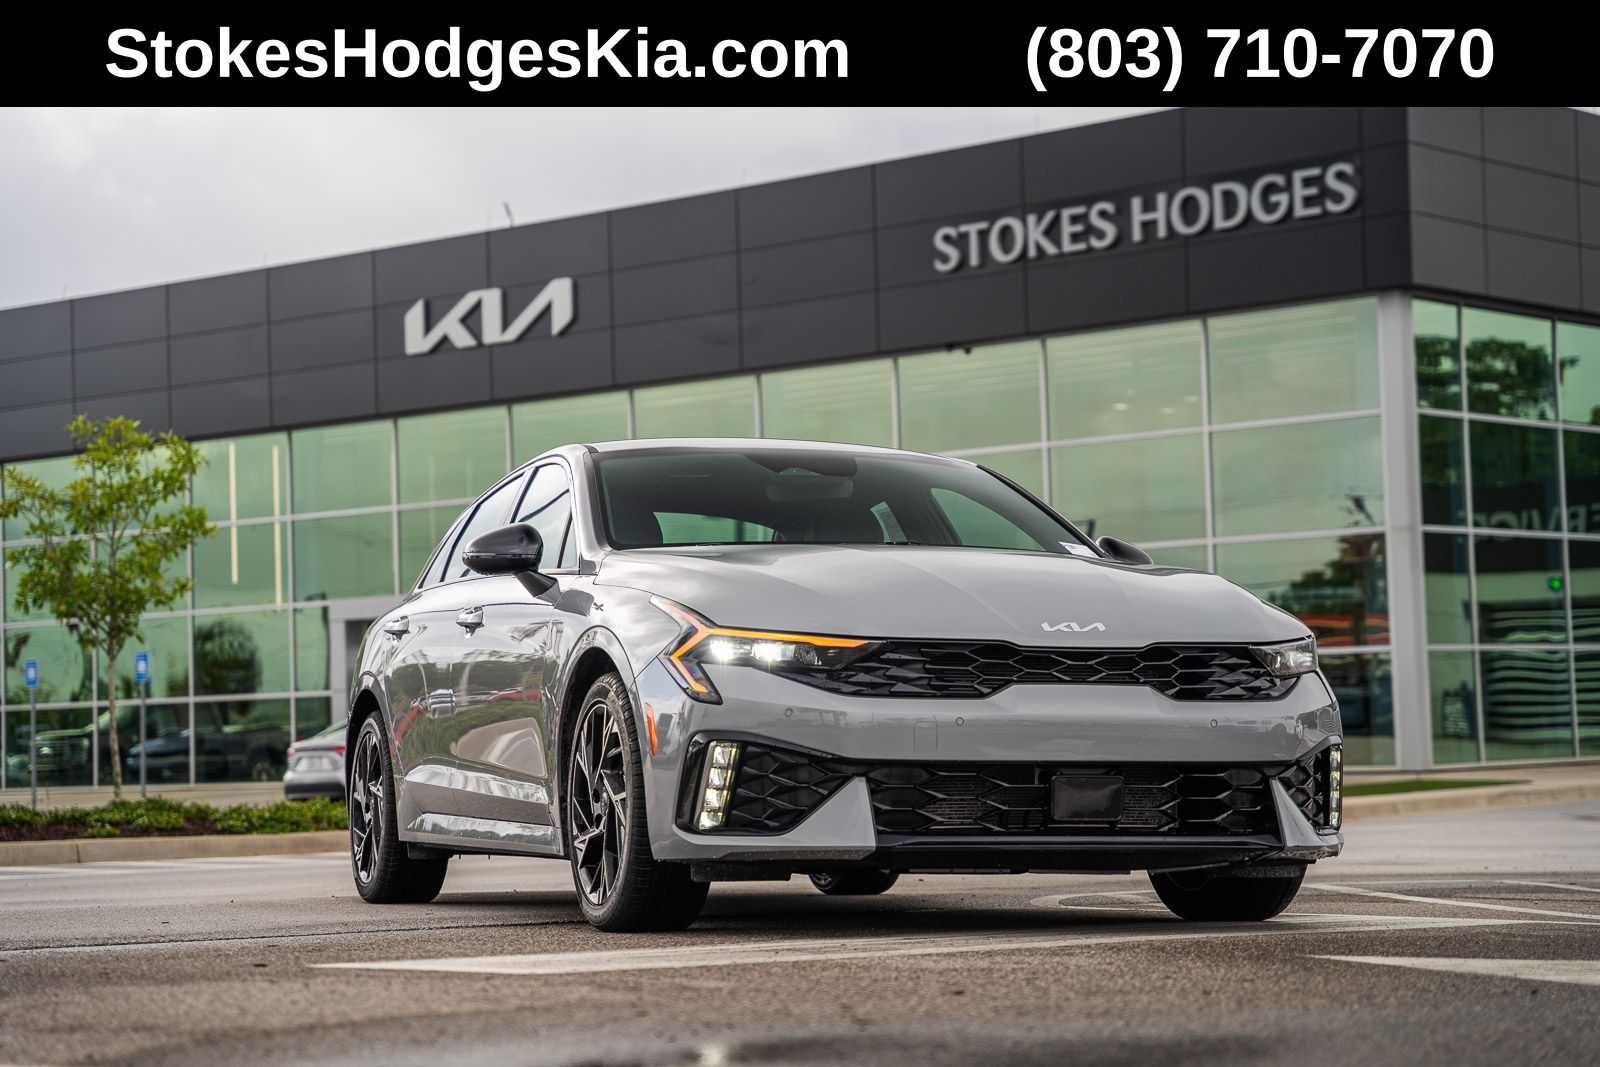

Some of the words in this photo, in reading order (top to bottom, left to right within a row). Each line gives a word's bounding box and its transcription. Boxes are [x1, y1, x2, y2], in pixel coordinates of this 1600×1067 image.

[933, 201, 1118, 274] STOKES
[1130, 161, 1358, 243] HODGES
[404, 276, 573, 356] KIA
[1040, 621, 1106, 633] KIA
